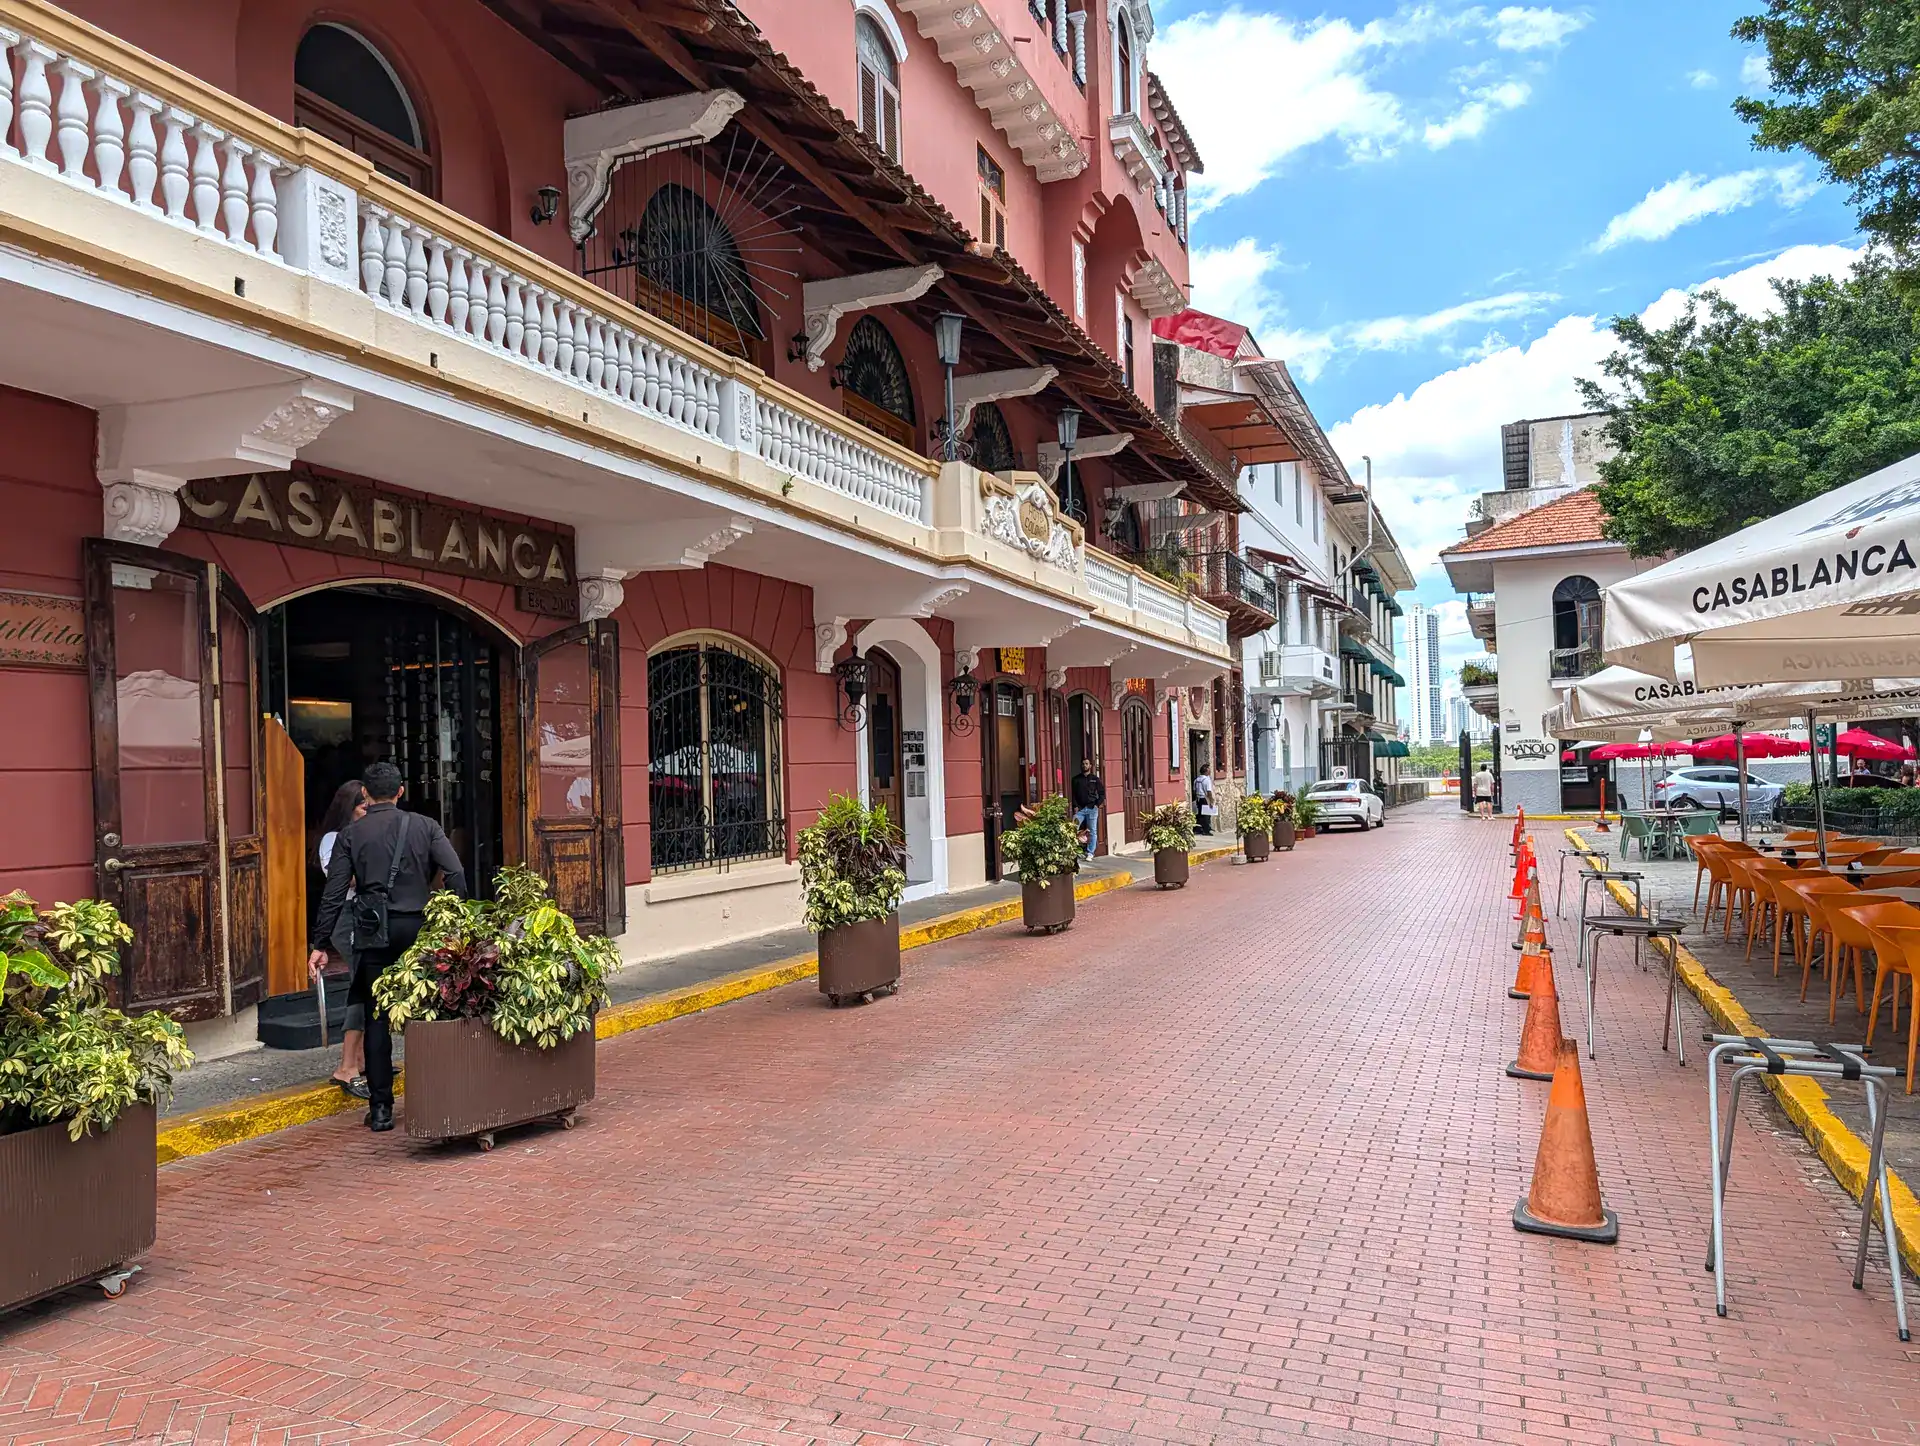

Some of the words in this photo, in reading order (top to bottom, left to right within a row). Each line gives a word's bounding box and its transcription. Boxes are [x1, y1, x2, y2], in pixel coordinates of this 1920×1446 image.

[181, 474, 571, 584] CASABLANCA
[1692, 539, 1917, 614] CASABLANCA
[1504, 743, 1556, 755] MANOLO
